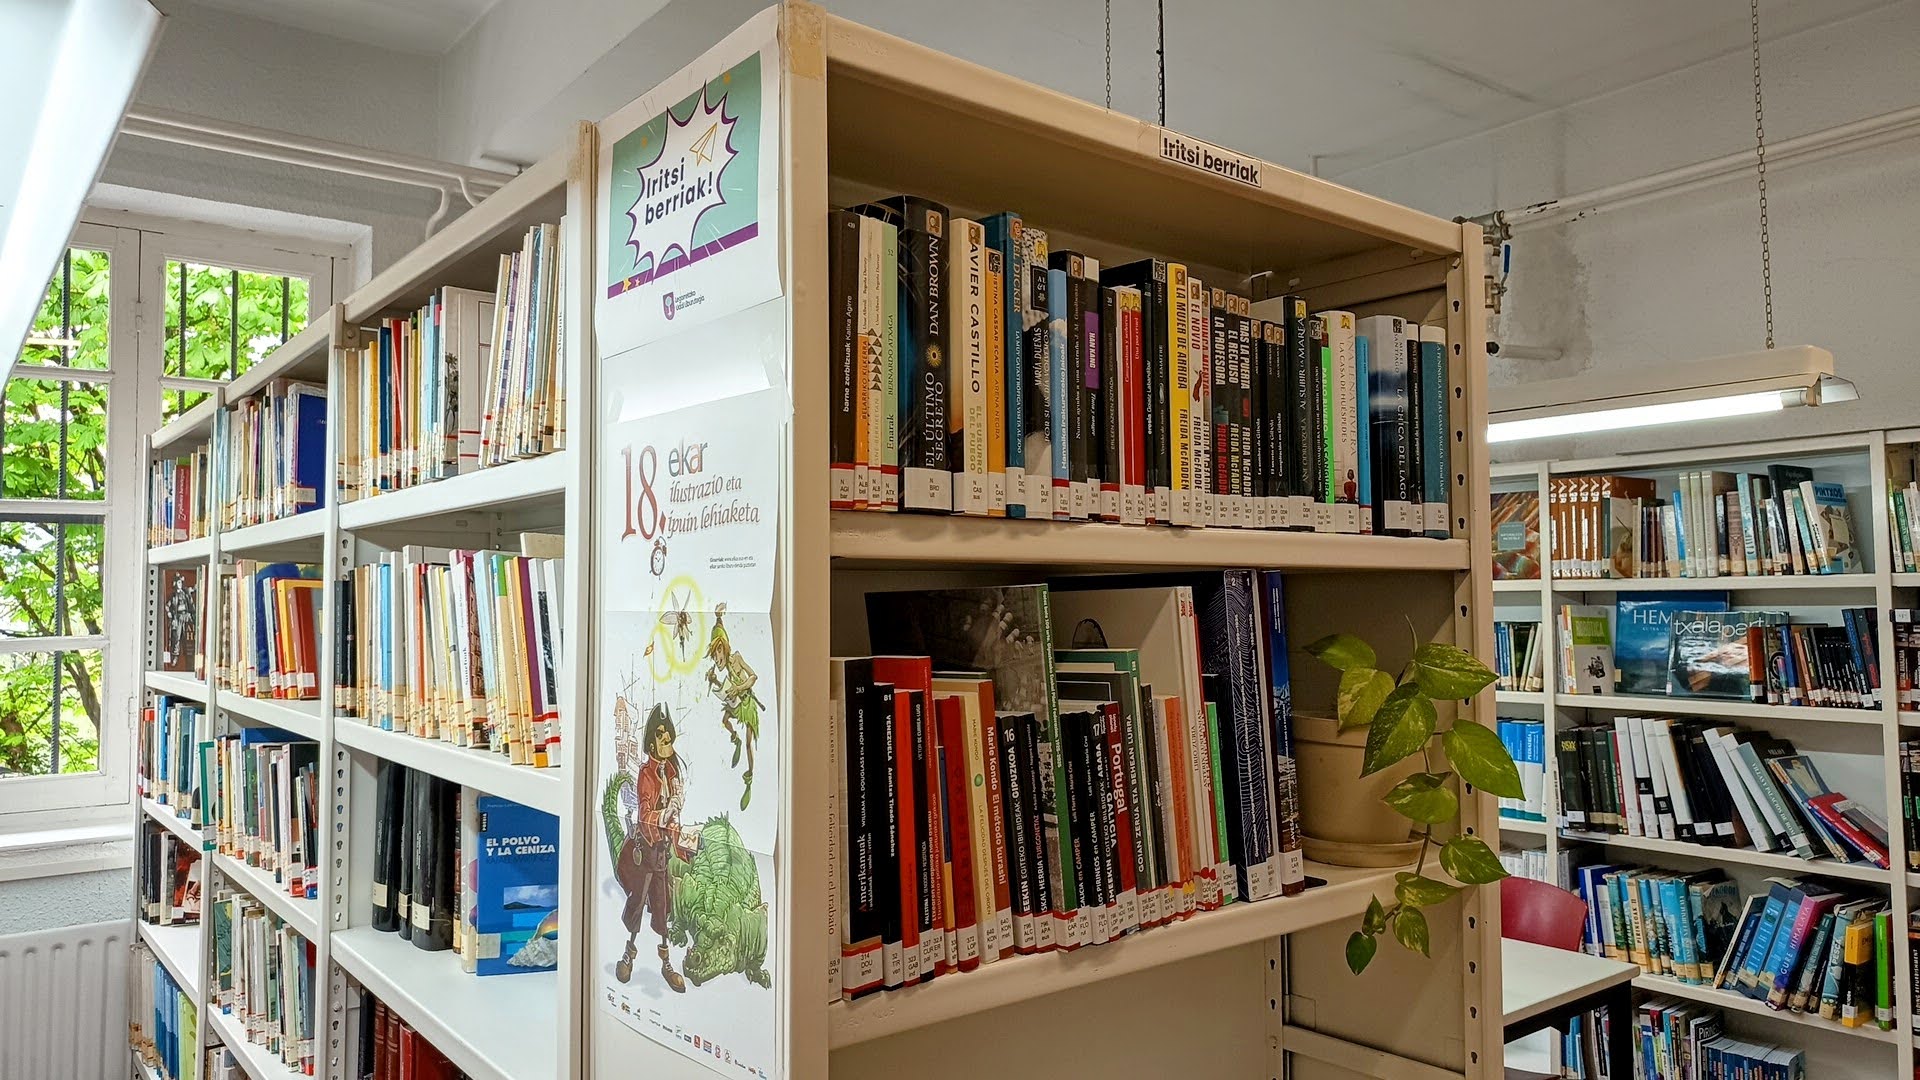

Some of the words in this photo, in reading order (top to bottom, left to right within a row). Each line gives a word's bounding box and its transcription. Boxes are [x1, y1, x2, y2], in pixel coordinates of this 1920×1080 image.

[1163, 136, 1200, 166] Iritsi
[1202, 151, 1259, 184] berriak
[646, 157, 684, 198] Iritsi
[645, 171, 713, 225] berriak!
[928, 236, 940, 299] BROWN
[970, 242, 980, 297] AVIER
[1013, 263, 1021, 313] DICKER
[1176, 287, 1186, 299] LA
[928, 301, 940, 337] DAN
[1176, 301, 1186, 335] MUJER
[1191, 303, 1201, 314] EL
[1214, 316, 1225, 328] LA
[970, 303, 980, 393] CASTILLO
[1032, 327, 1043, 360] DUEÑAS
[1177, 337, 1187, 350] DE
[1191, 317, 1201, 350] NOVIO
[1228, 329, 1239, 339] EL
[1239, 320, 1250, 343] TRAS
[1297, 317, 1306, 360] MAREA
[1214, 330, 1226, 385] PROFESORA
[1228, 341, 1239, 384] RECLUSO
[1240, 344, 1250, 355] LA
[1032, 361, 1043, 387] MARÍA
[1177, 352, 1188, 389] ARRIBA
[1240, 356, 1251, 390] PUERTA
[1298, 369, 1307, 398] SUBIR
[923, 371, 936, 441] ÚLTIMO
[1397, 388, 1404, 401] LA
[935, 380, 945, 462] SECRETO
[969, 407, 977, 429] DEL
[976, 405, 983, 419] EL
[1179, 408, 1188, 439] FREIDA
[1397, 405, 1405, 441] CHICA
[886, 413, 894, 450] Enarak
[1193, 416, 1202, 446] FREIDA
[1217, 423, 1228, 453] FREIDA
[1230, 422, 1240, 453] FREIDA
[1242, 426, 1251, 456] FREIDA
[925, 446, 936, 467] EL
[969, 432, 977, 471] FUEGO
[1180, 442, 1190, 491] McFADDEN
[1398, 445, 1406, 466] DEL
[726, 476, 742, 492] eta
[1193, 449, 1203, 490] McFADDE
[1230, 455, 1240, 495] McFADDE
[1242, 458, 1252, 497] McFADDE
[1399, 470, 1407, 500] LAGO
[667, 510, 698, 538] ipuin
[700, 499, 760, 530] lehiaketa
[1633, 609, 1672, 625] HEM
[1673, 615, 1767, 641] txalapart
[885, 714, 893, 762] VENEZUELA
[987, 726, 996, 756] Marie
[1004, 728, 1016, 743] 16
[1092, 722, 1101, 737] 17
[1125, 714, 1135, 745] LURRA
[989, 757, 998, 791] Kondo
[1008, 747, 1021, 799] GIPUZKOA
[1094, 742, 1105, 778] ARABA
[1128, 746, 1138, 785] BEHEAN
[1111, 742, 1128, 814] Portugal
[992, 793, 1000, 804] El
[1131, 786, 1139, 805] ETA
[993, 805, 1003, 845] método
[1014, 802, 1025, 845] IBILBIDEAK
[1088, 812, 1099, 843] CAMPER
[1106, 792, 1117, 848] GALICIA
[1133, 806, 1142, 839] ZERUA
[486, 837, 499, 847] EL
[502, 835, 541, 847] POLVO
[486, 847, 495, 857] Y
[497, 846, 512, 856] LA
[515, 844, 556, 855] CENIZA
[1073, 837, 1083, 870] CAMPER
[1102, 824, 1112, 858] EGITEKO
[1136, 840, 1145, 873] GOIAN
[857, 834, 867, 912] Amerikanuak
[996, 846, 1007, 885] kurashi
[1017, 846, 1028, 880] EGITEKO
[1036, 860, 1046, 891] HERRIA
[1093, 856, 1103, 892] PIRINEOS
[1077, 882, 1087, 909] GALICIA
[1780, 951, 1794, 975] GURE
[1790, 906, 1811, 950] HIMALAYA
[1831, 940, 1842, 965] PESCA
